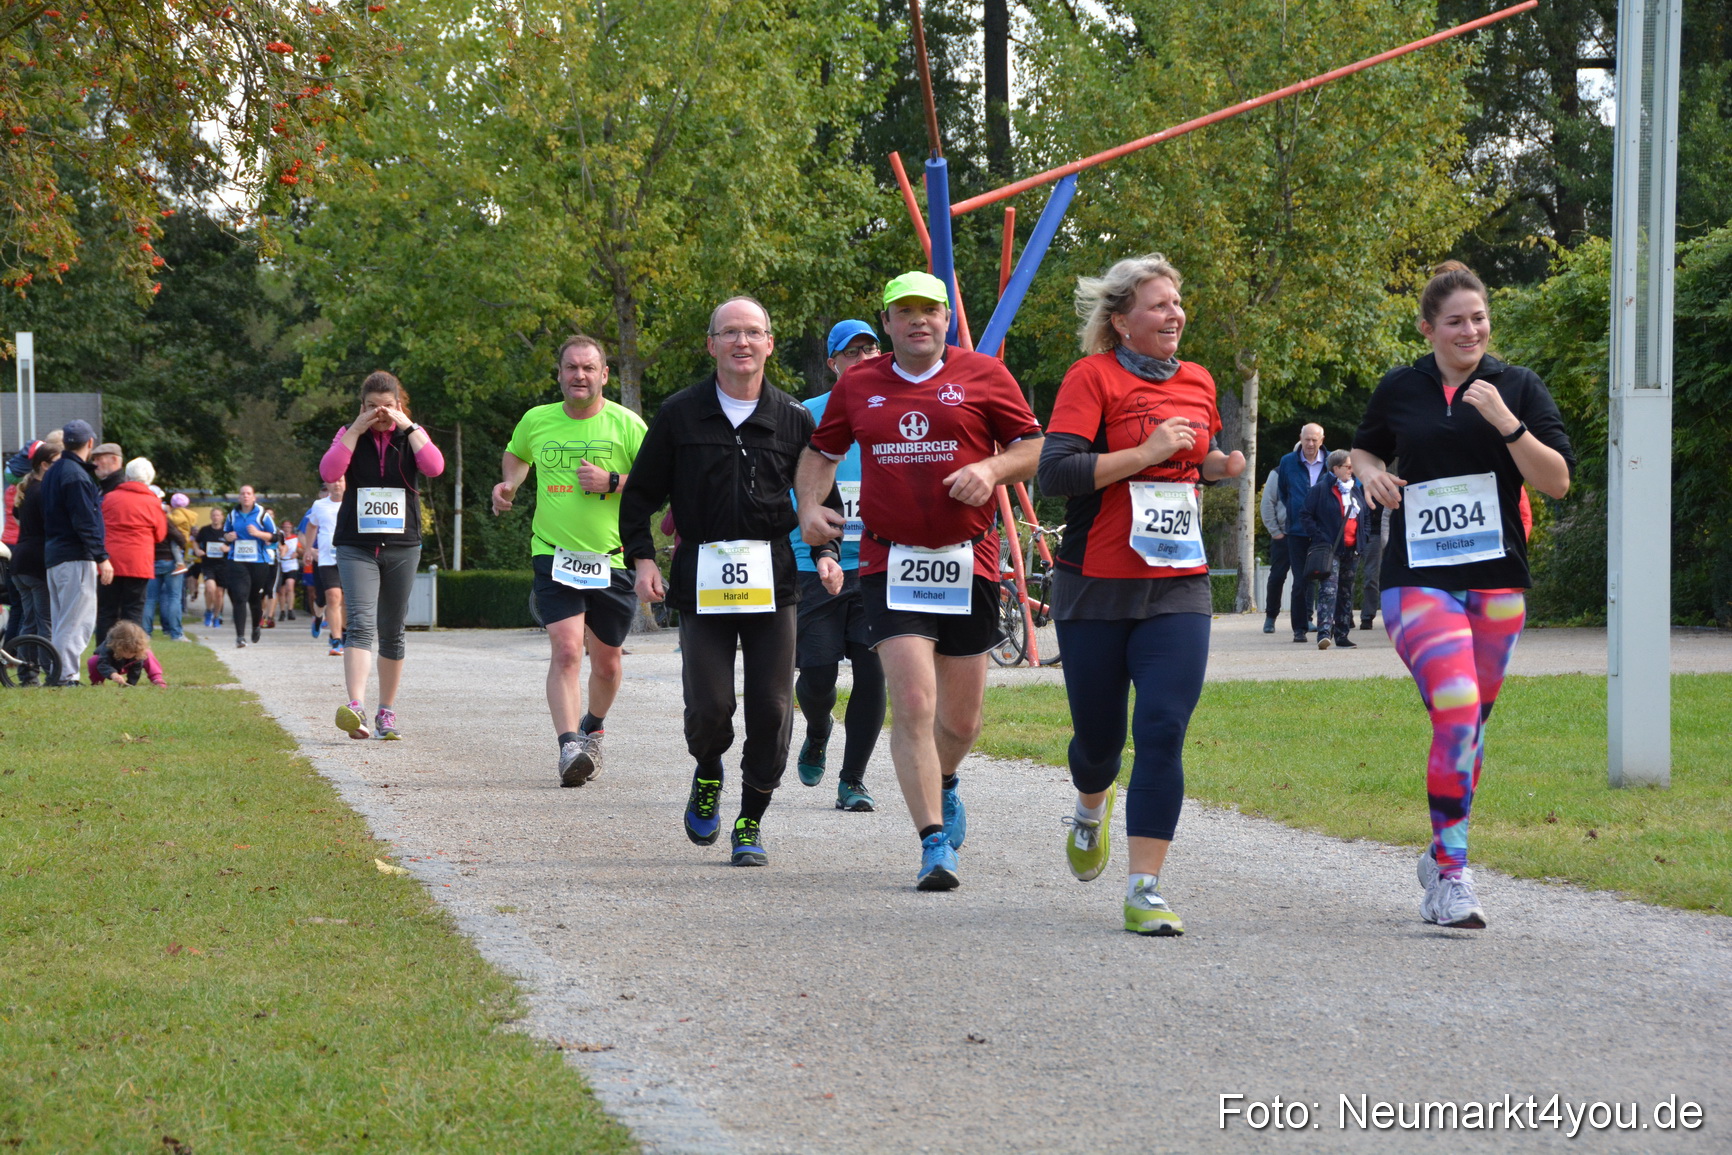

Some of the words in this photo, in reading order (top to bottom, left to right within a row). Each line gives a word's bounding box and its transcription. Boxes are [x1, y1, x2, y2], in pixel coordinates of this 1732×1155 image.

[941, 392, 962, 400] FCN
[872, 440, 958, 455] NÜRNBERGER
[877, 453, 954, 464] VERSICHERUNG
[364, 501, 399, 515] 2606
[1144, 508, 1191, 535] 2529
[1418, 501, 1486, 534] 2034
[1157, 543, 1179, 555] Birgit
[1436, 539, 1475, 551] Felicitas
[561, 556, 602, 575] 2090
[900, 559, 961, 584] 2509
[573, 576, 588, 584] Sepp
[721, 562, 749, 585] 85
[723, 592, 749, 601] Harald
[912, 590, 946, 600] Michael
